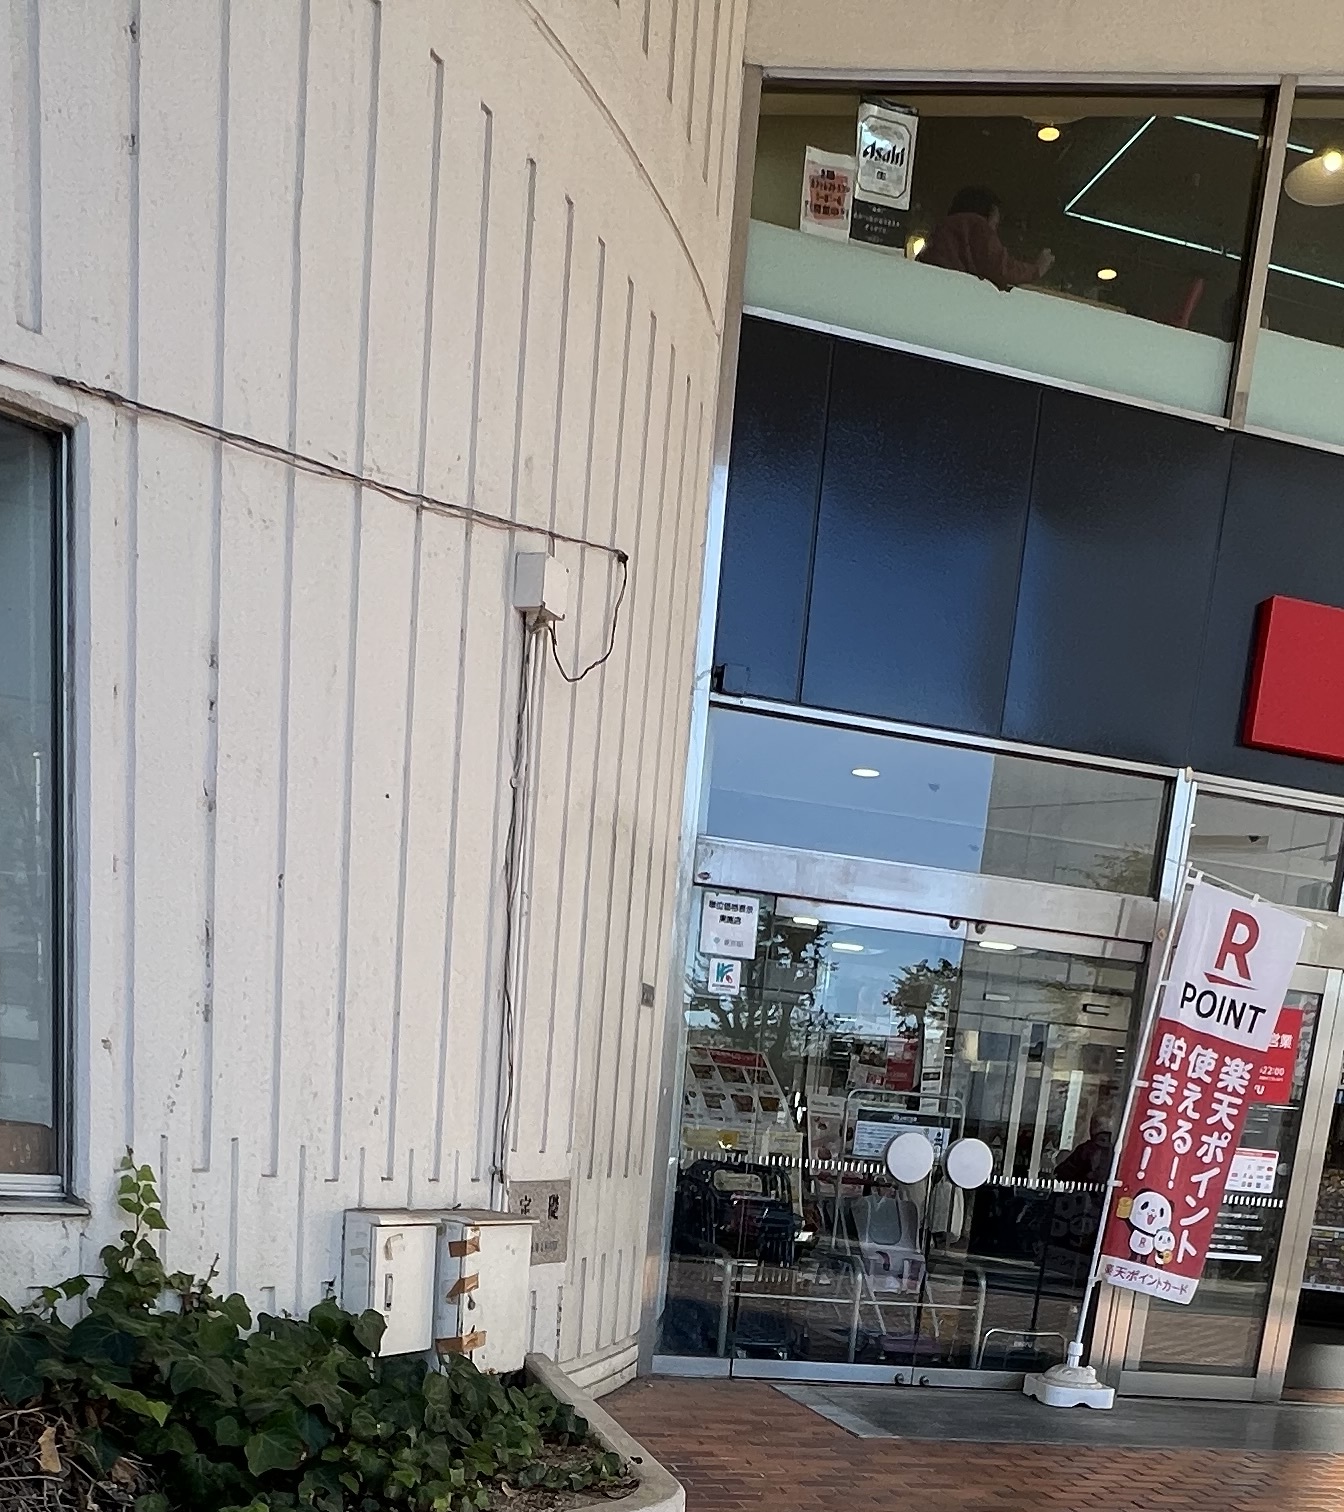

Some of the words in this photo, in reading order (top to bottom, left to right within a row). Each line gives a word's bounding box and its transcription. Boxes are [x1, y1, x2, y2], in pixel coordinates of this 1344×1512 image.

[862, 140, 906, 168] Asahi
[1180, 981, 1266, 1036] POINT
[1175, 1054, 1254, 1263] 楽天ポイント
[1104, 1263, 1189, 1296] 楽天ポイントカード
